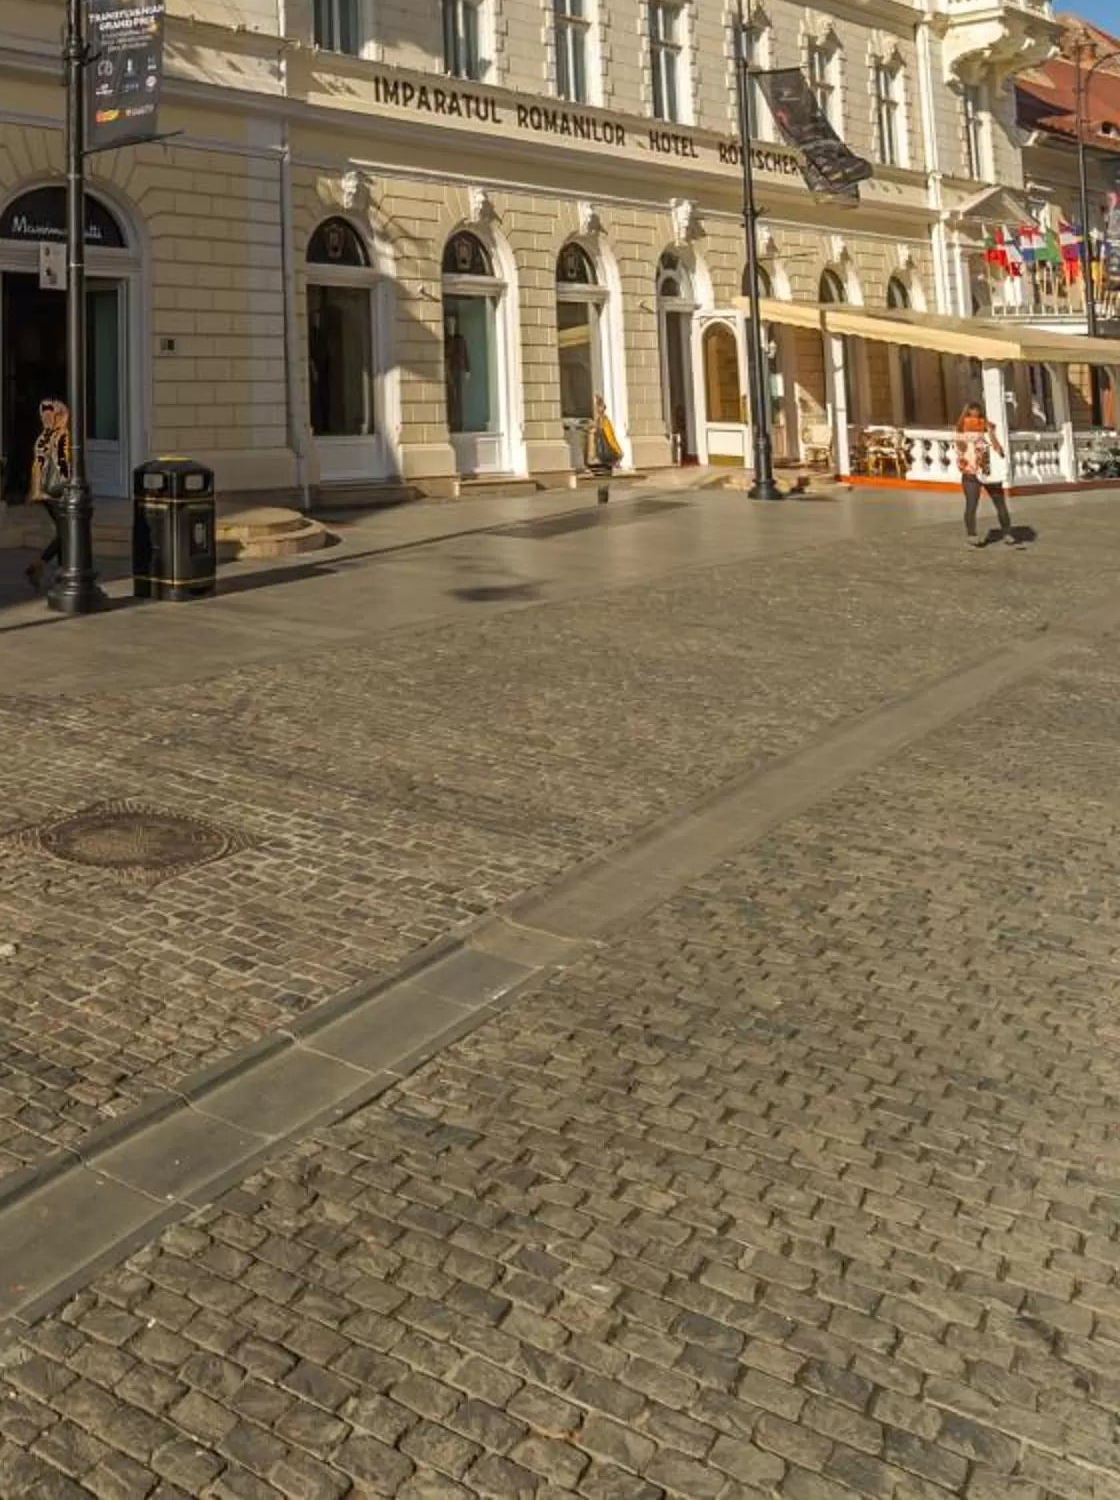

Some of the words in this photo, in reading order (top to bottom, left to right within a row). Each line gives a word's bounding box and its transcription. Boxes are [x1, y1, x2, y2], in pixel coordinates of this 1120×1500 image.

[373, 76, 503, 124] IMPARATUL
[517, 103, 626, 146] ROMANILOR
[649, 129, 699, 158] HOTEL
